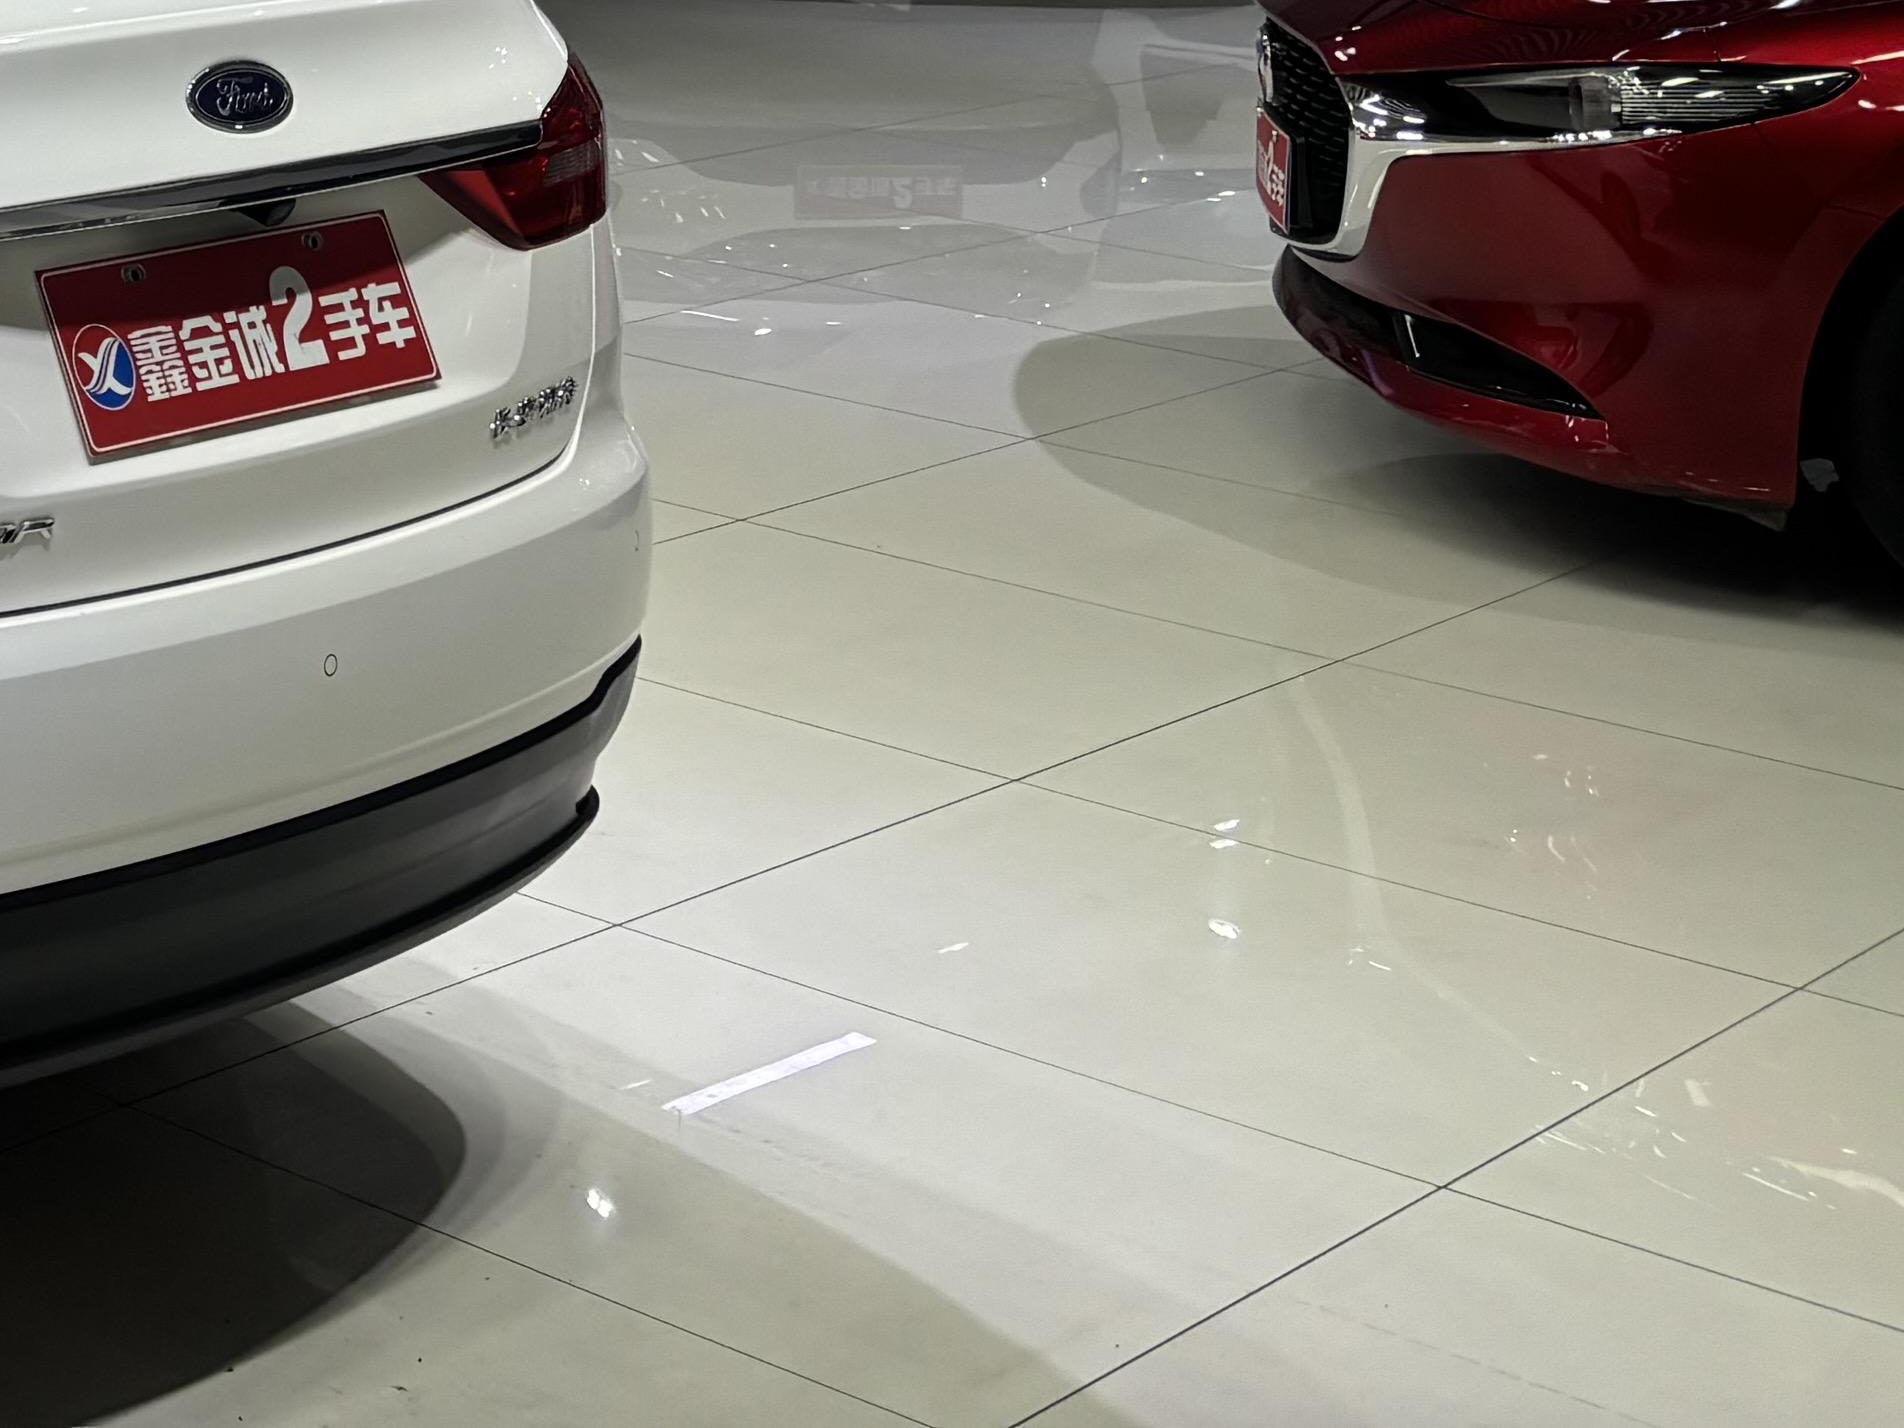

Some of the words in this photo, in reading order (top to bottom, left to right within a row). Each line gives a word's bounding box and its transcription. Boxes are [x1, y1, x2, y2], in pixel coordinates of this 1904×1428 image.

[216, 77, 274, 117] Ford
[127, 266, 418, 402] 鑫金诚2手车
